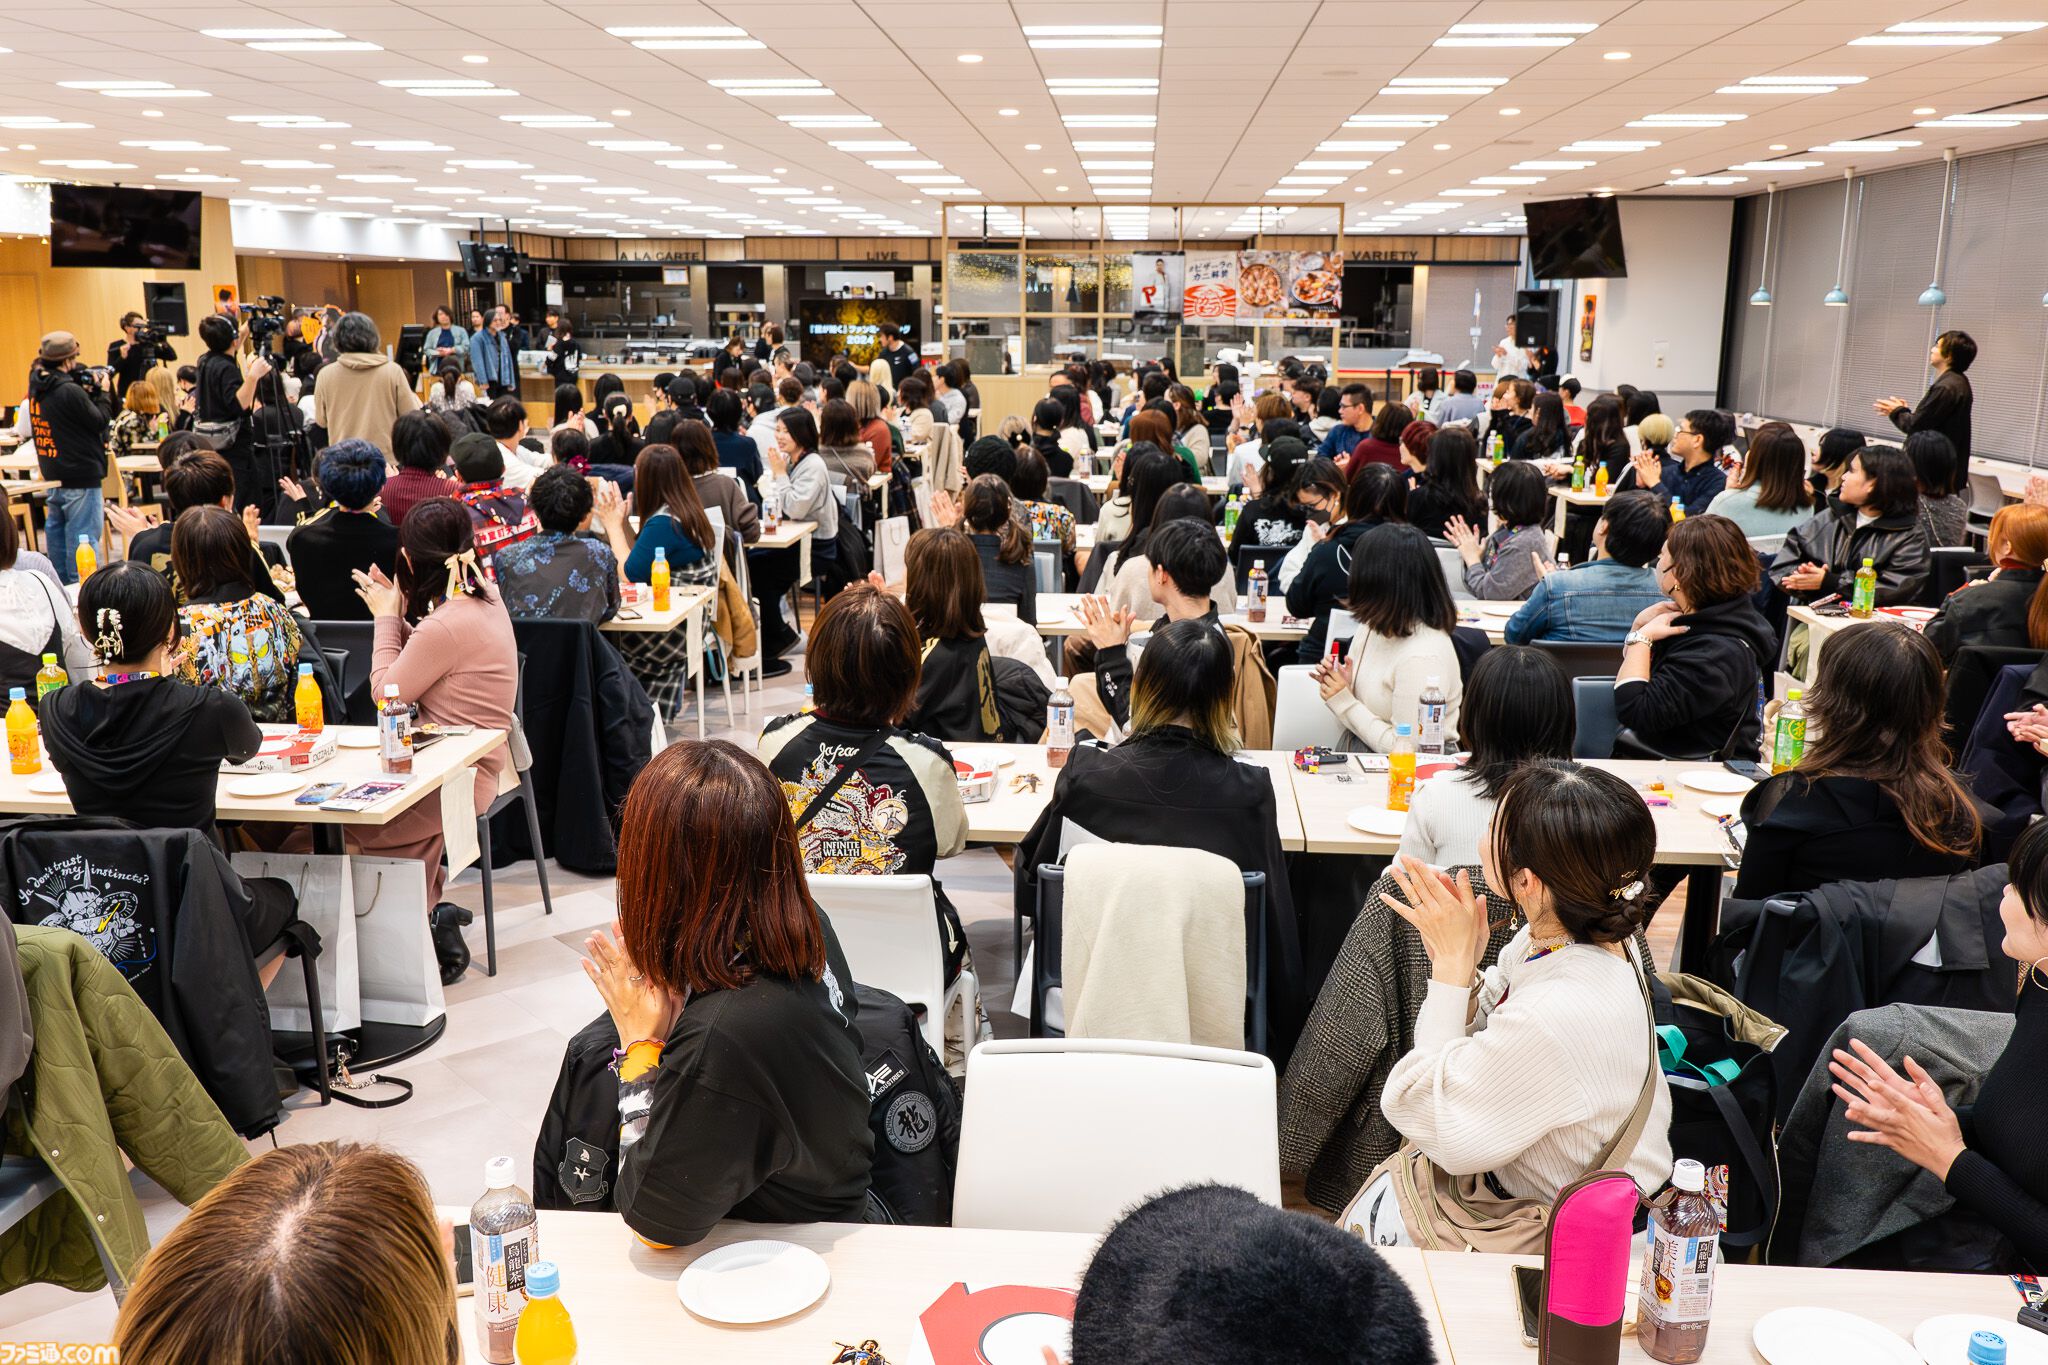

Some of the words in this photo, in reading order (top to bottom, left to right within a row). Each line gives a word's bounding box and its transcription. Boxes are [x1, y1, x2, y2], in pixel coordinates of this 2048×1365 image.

[620, 252, 628, 260] A
[634, 252, 651, 260] LA
[656, 252, 700, 260] CARTE
[867, 251, 898, 261] LIVE
[1352, 251, 1418, 260] VARIETY
[1141, 286, 1157, 304] P
[846, 334, 875, 345] 2024
[823, 841, 860, 849] INFINITE
[823, 849, 860, 857] WEALTH
[53, 854, 82, 872] trust
[91, 863, 150, 885] instincts?
[875, 1069, 905, 1097] INDUSTRIES
[507, 1245, 523, 1285] 烏龍茶
[1664, 1239, 1678, 1278] 美味
[486, 1264, 509, 1314] 健康
